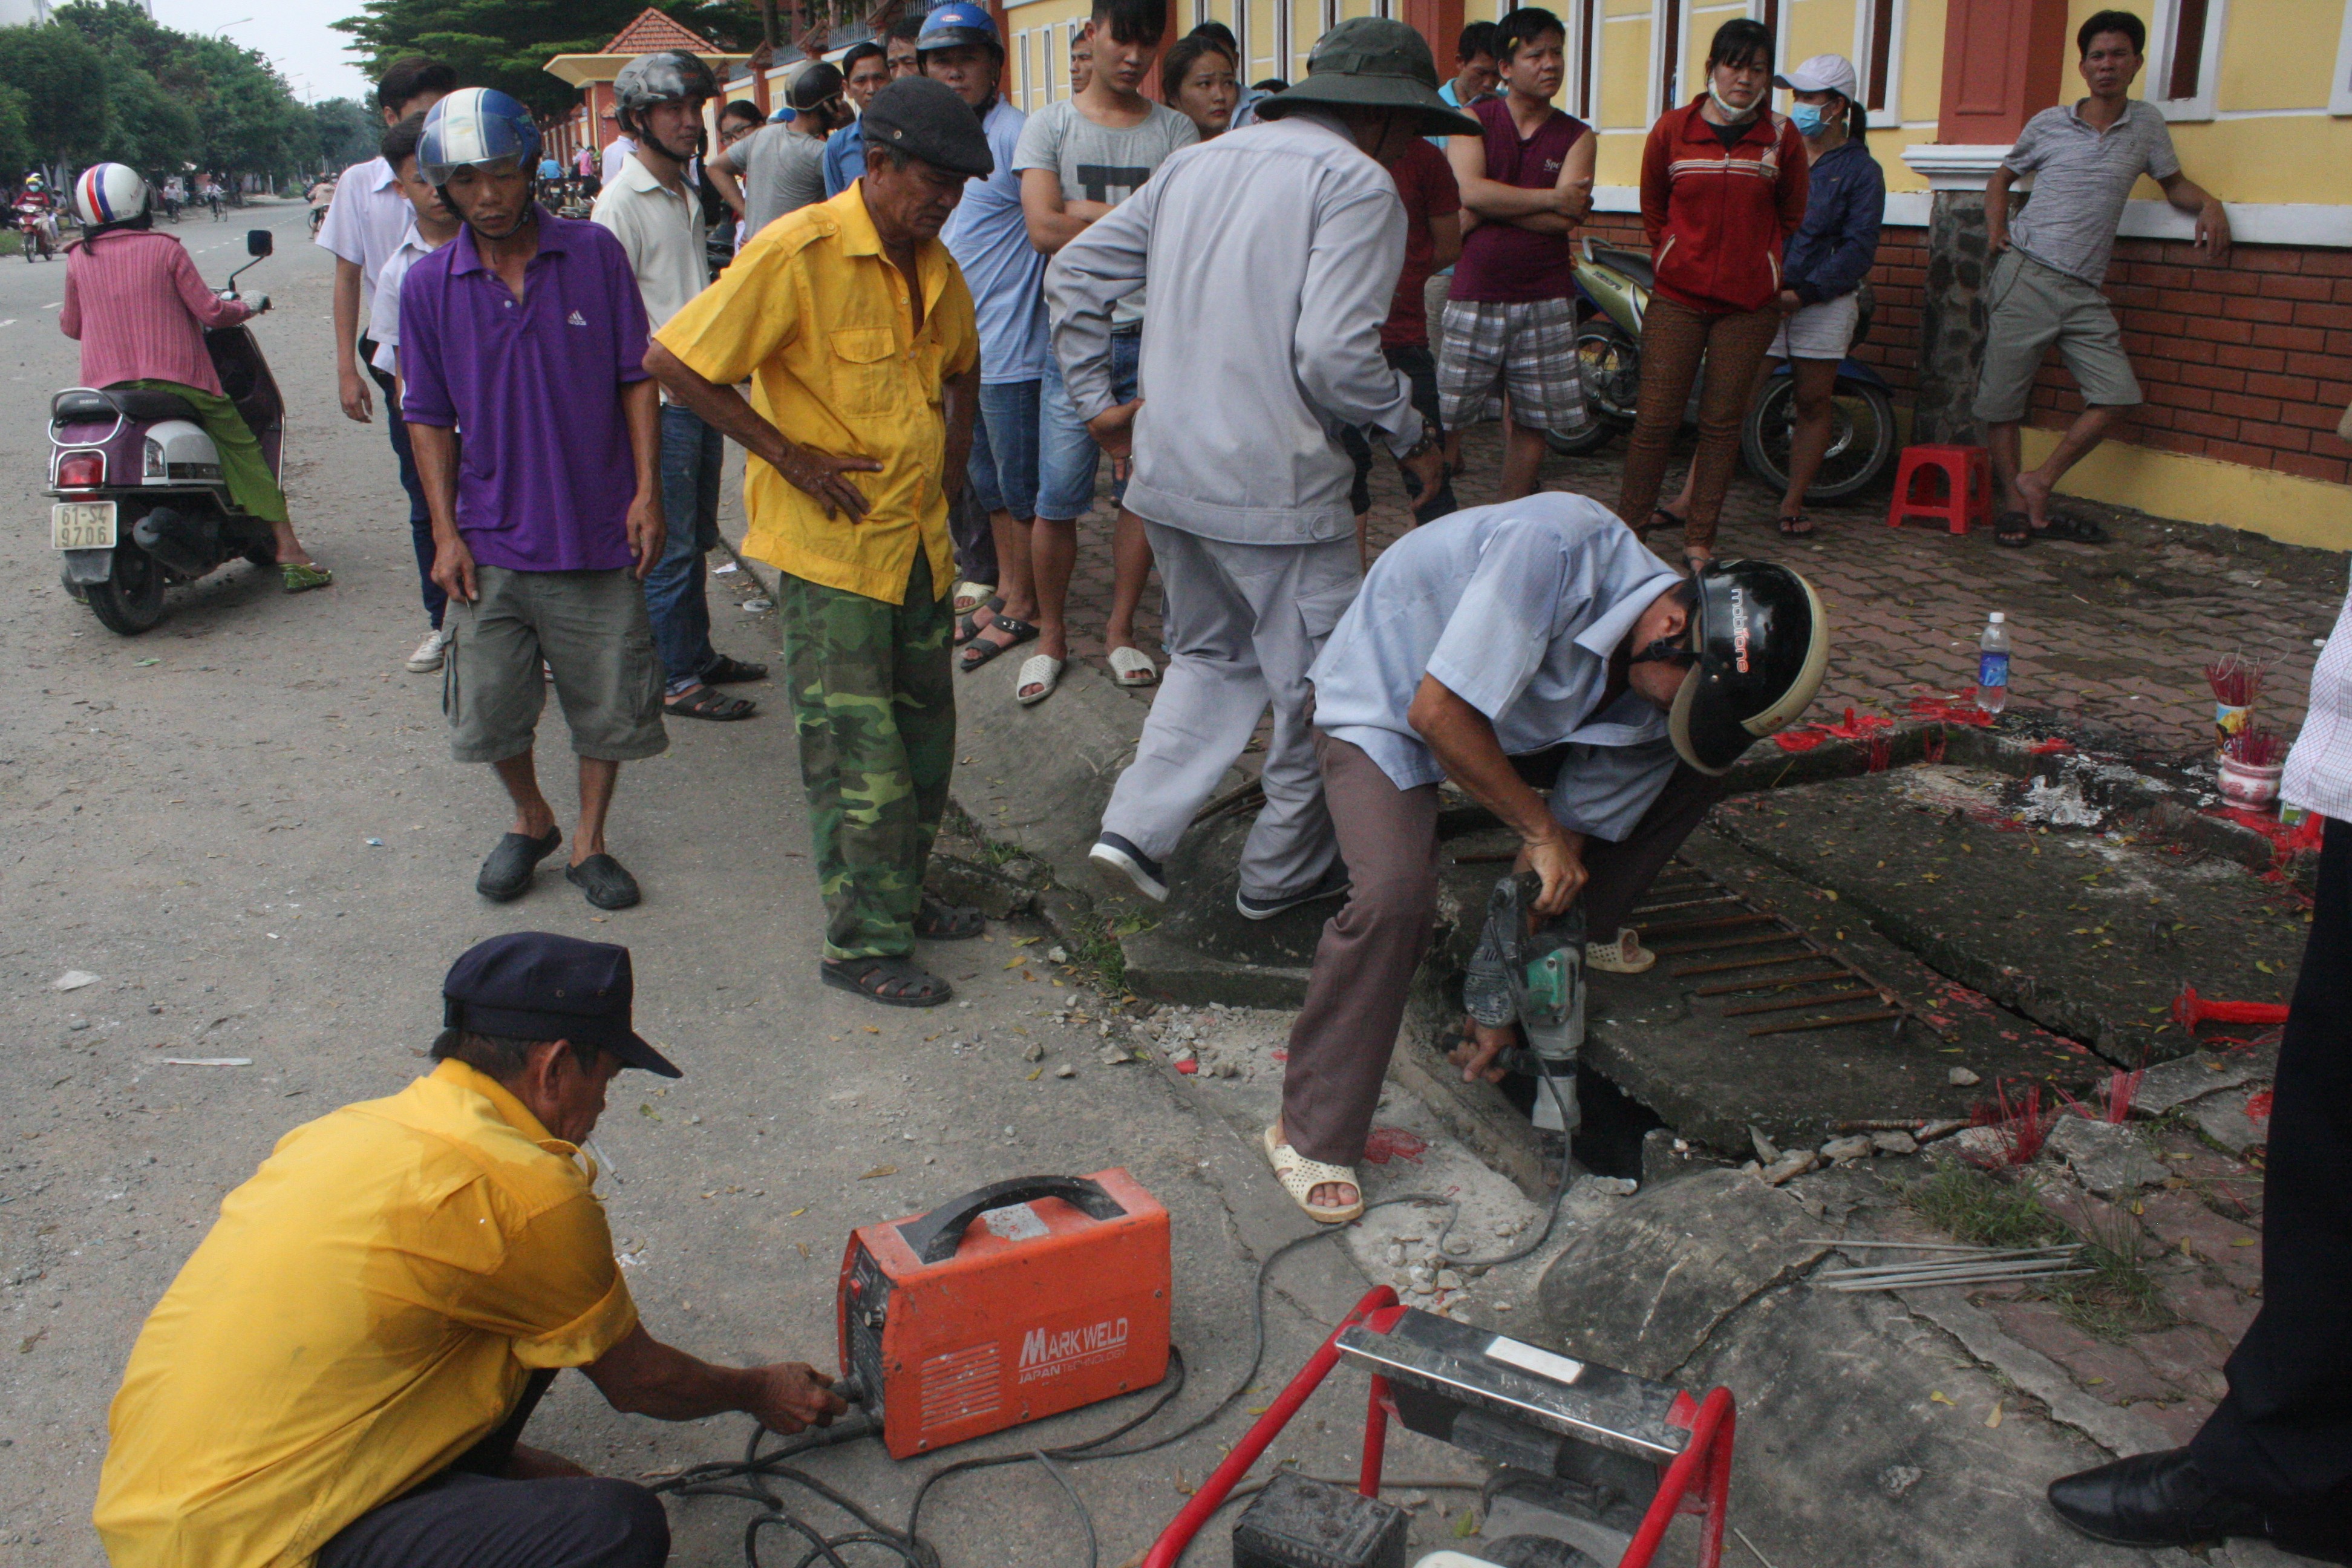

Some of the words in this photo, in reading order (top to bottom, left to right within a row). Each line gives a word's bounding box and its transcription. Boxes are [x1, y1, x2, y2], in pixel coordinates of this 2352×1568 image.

[62, 504, 106, 525] 61-S4
[62, 526, 106, 547] 9706
[1731, 589, 1749, 673] mobifone
[1018, 1365, 1060, 1385] JAPAN
[1063, 1348, 1128, 1373] TECHNOLOGY
